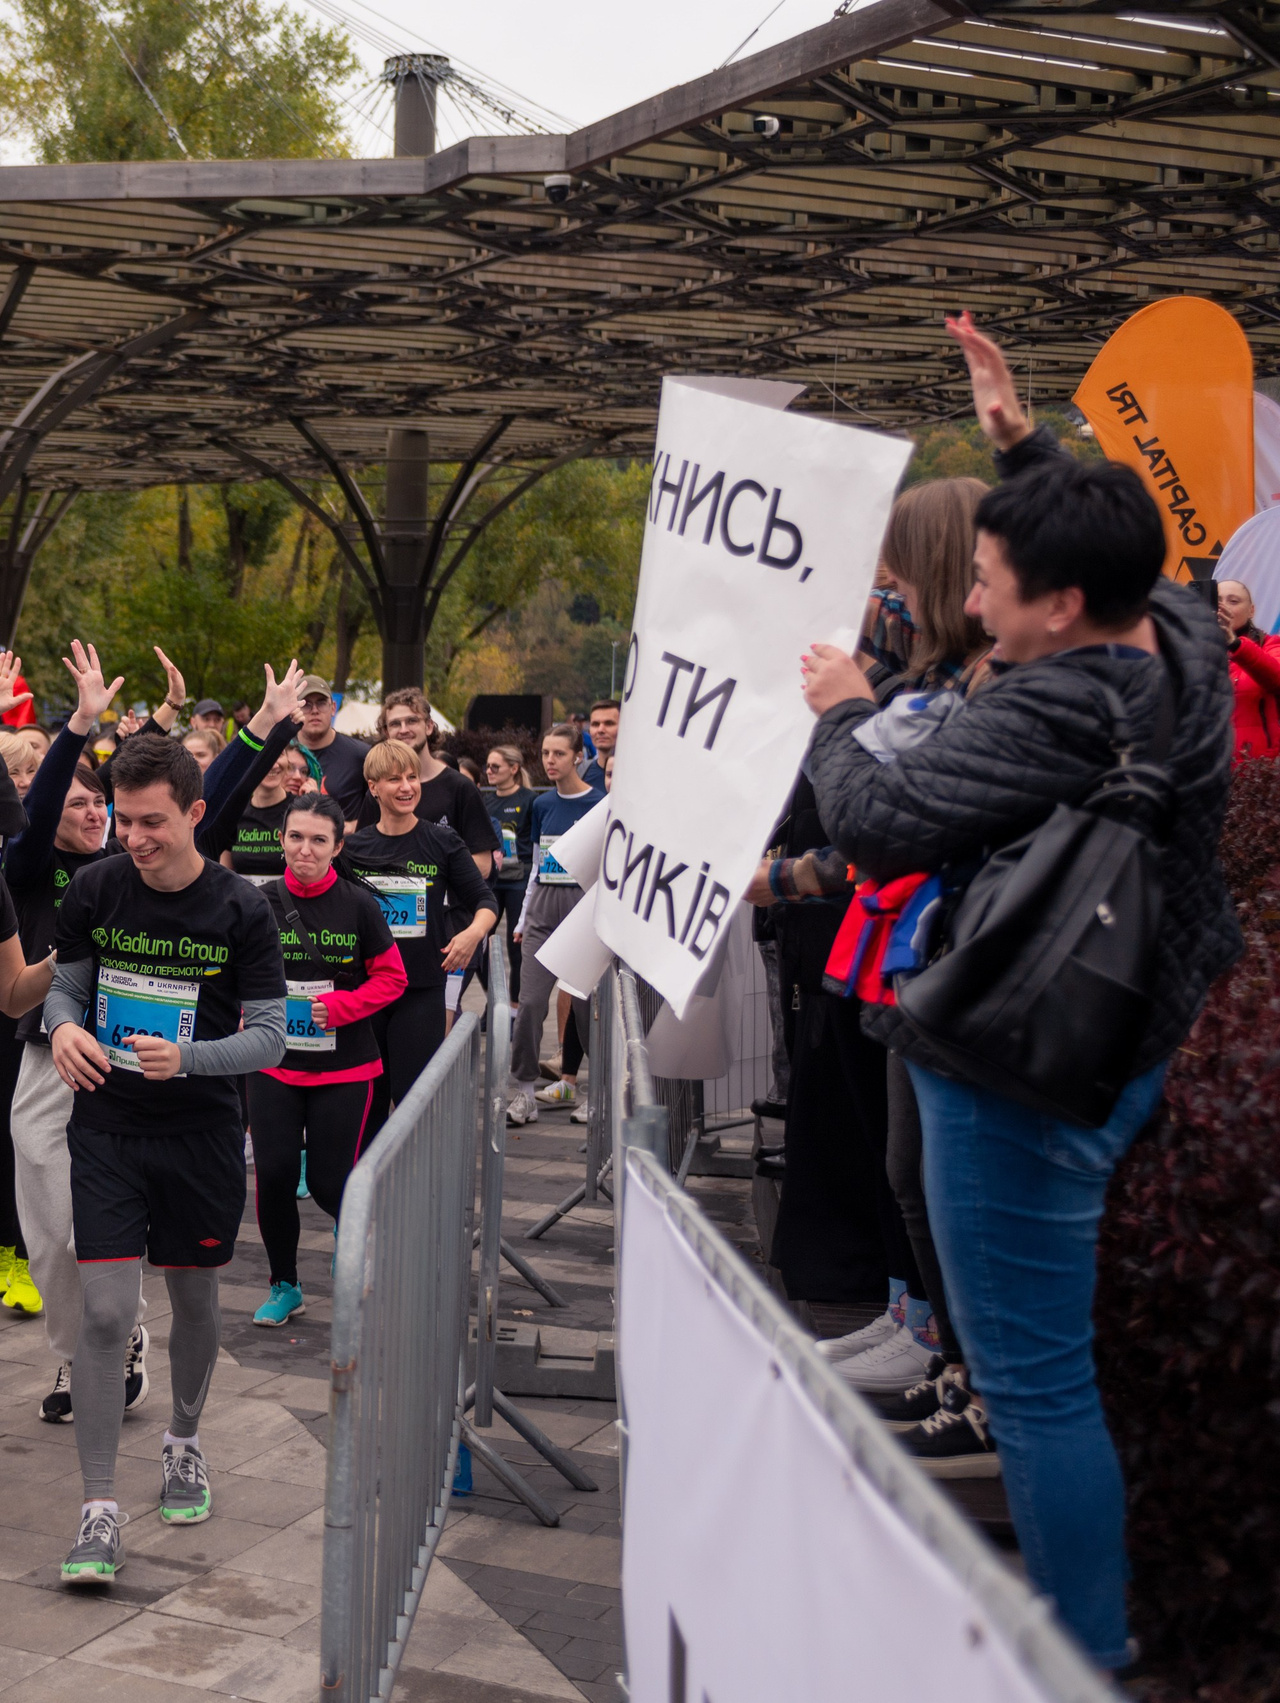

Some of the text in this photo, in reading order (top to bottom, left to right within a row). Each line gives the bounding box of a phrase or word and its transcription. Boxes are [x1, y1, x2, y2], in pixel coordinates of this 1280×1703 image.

[656, 650, 737, 751] ТИ
[238, 828, 271, 842] Kadium
[406, 860, 438, 877] Group
[382, 910, 409, 925] 729
[111, 928, 229, 964] Kadium Group
[321, 929, 357, 951] Group
[139, 964, 153, 976] ДО
[154, 965, 204, 977] ПЕРЕМОГИ
[157, 982, 197, 993] UKRNAFTA
[286, 1019, 316, 1036] 656
[111, 1024, 164, 1049] 67
[115, 1056, 140, 1068] Прива
